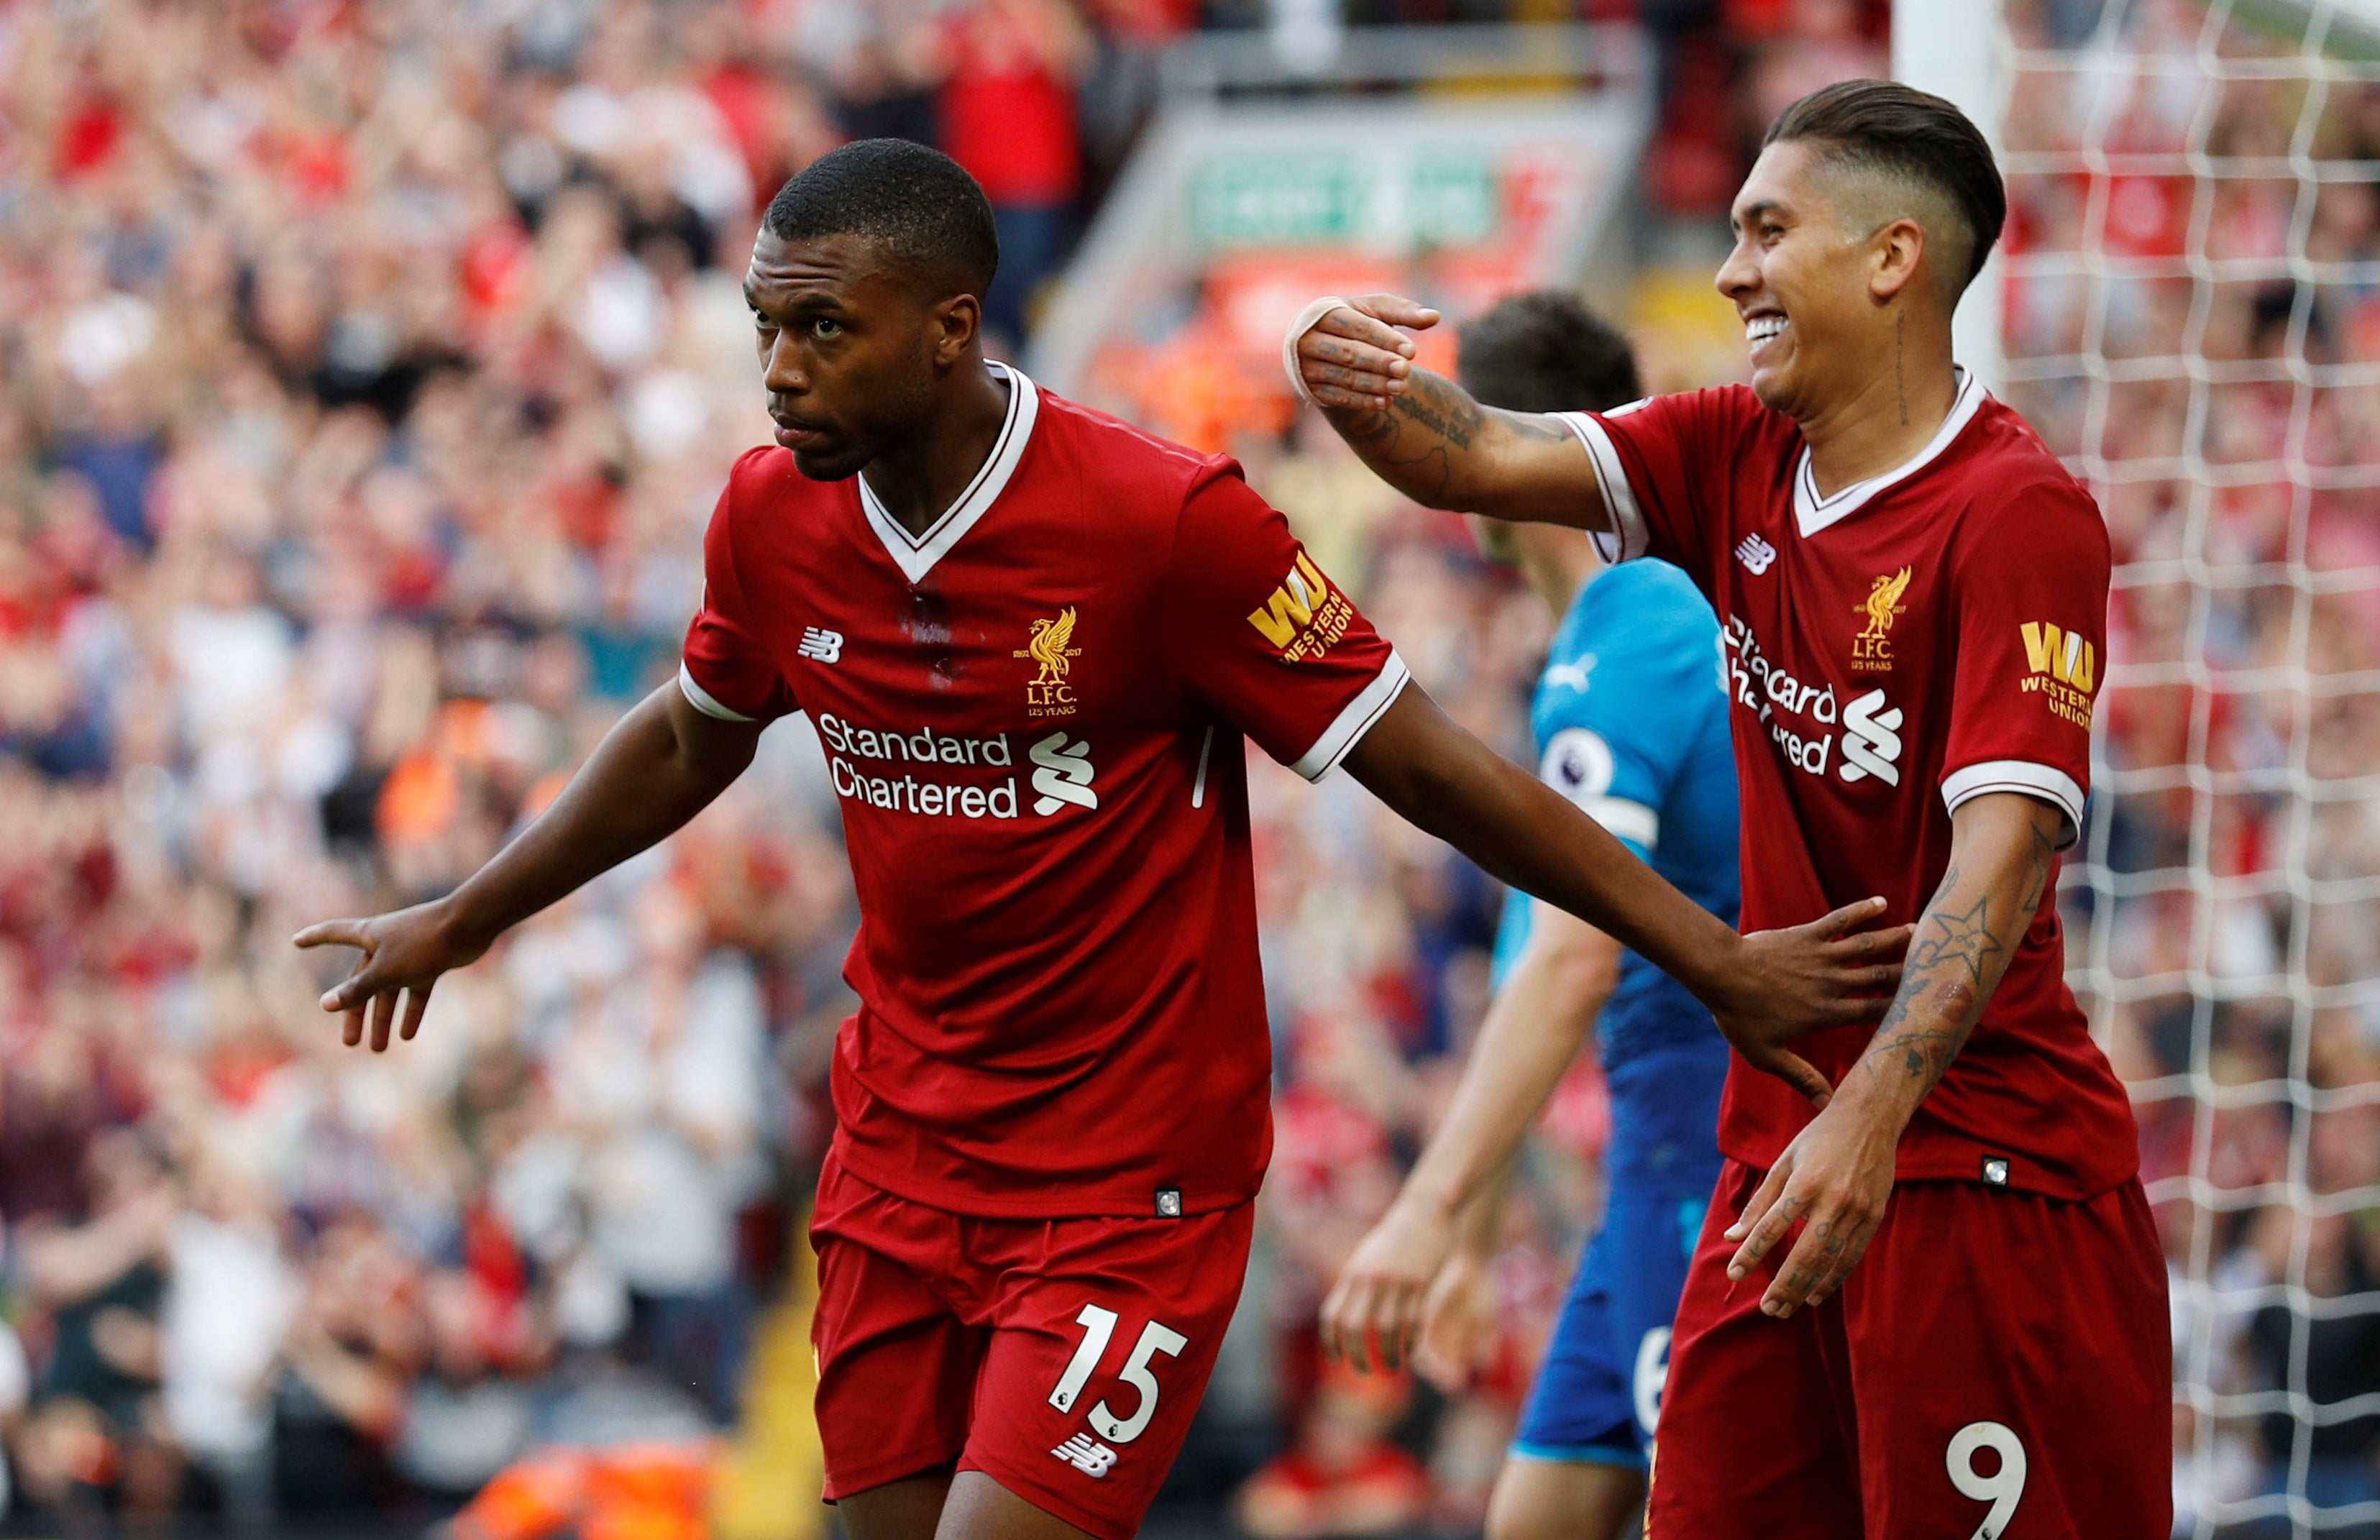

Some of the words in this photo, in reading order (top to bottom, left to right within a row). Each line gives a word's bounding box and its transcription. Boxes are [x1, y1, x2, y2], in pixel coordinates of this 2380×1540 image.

[1246, 549, 1327, 650] WU
[1278, 590, 1342, 666] WESTERN
[1311, 602, 1353, 659] UNION
[1064, 648, 1082, 657] 2017
[1723, 613, 1836, 725] Stadard
[2020, 620, 2095, 695] WU
[1027, 686, 1077, 705] L.F.C.
[1028, 707, 1043, 716] 125
[1044, 705, 1076, 717] YEARS
[819, 712, 1012, 766] Standard
[831, 756, 1018, 819] Chartered
[1048, 1303, 1189, 1444] 15
[1946, 1420, 2028, 1540] 9
